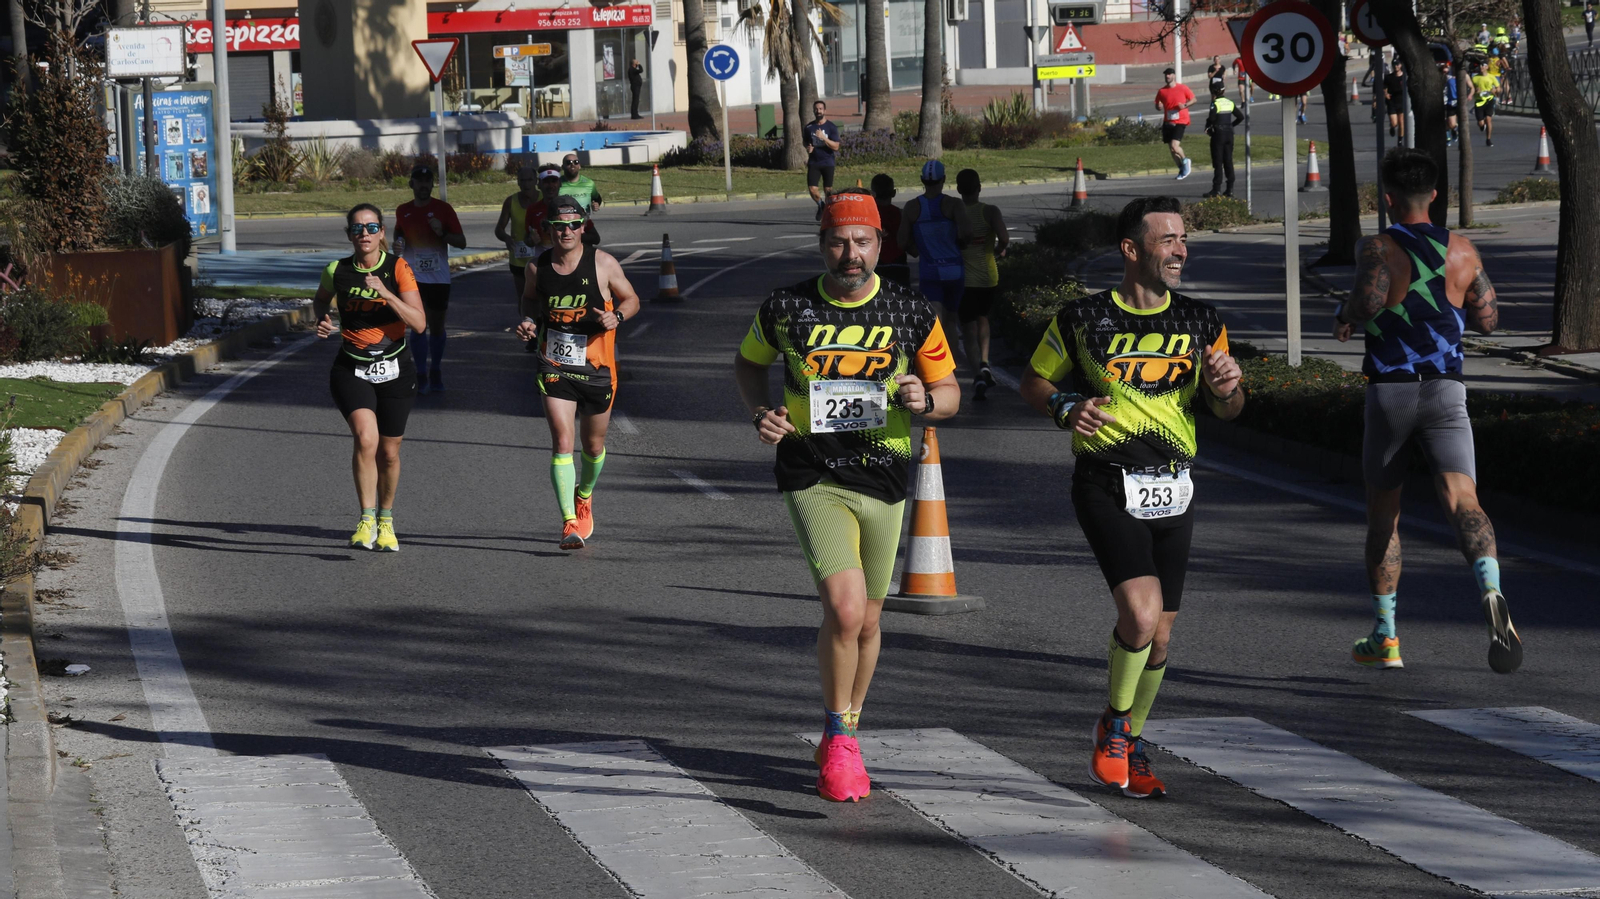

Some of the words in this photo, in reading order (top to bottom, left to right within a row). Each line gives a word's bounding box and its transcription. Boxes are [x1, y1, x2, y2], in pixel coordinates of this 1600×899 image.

[537, 19, 552, 27] 956
[568, 18, 581, 26] 252
[592, 8, 626, 26] telepizza
[185, 22, 300, 51] teepizza
[1261, 32, 1315, 64] 30
[110, 58, 154, 66] CarlosCano
[519, 246, 528, 254] 40
[419, 260, 433, 268] 257
[548, 294, 587, 307] non
[806, 324, 893, 347] non
[1106, 332, 1191, 354] non
[552, 341, 573, 358] 262
[364, 363, 386, 376] 245
[801, 350, 893, 377] STOP
[1101, 357, 1193, 382] STOP
[826, 398, 864, 419] 235
[1138, 486, 1173, 508] 253
[1142, 509, 1172, 517] EVOS
